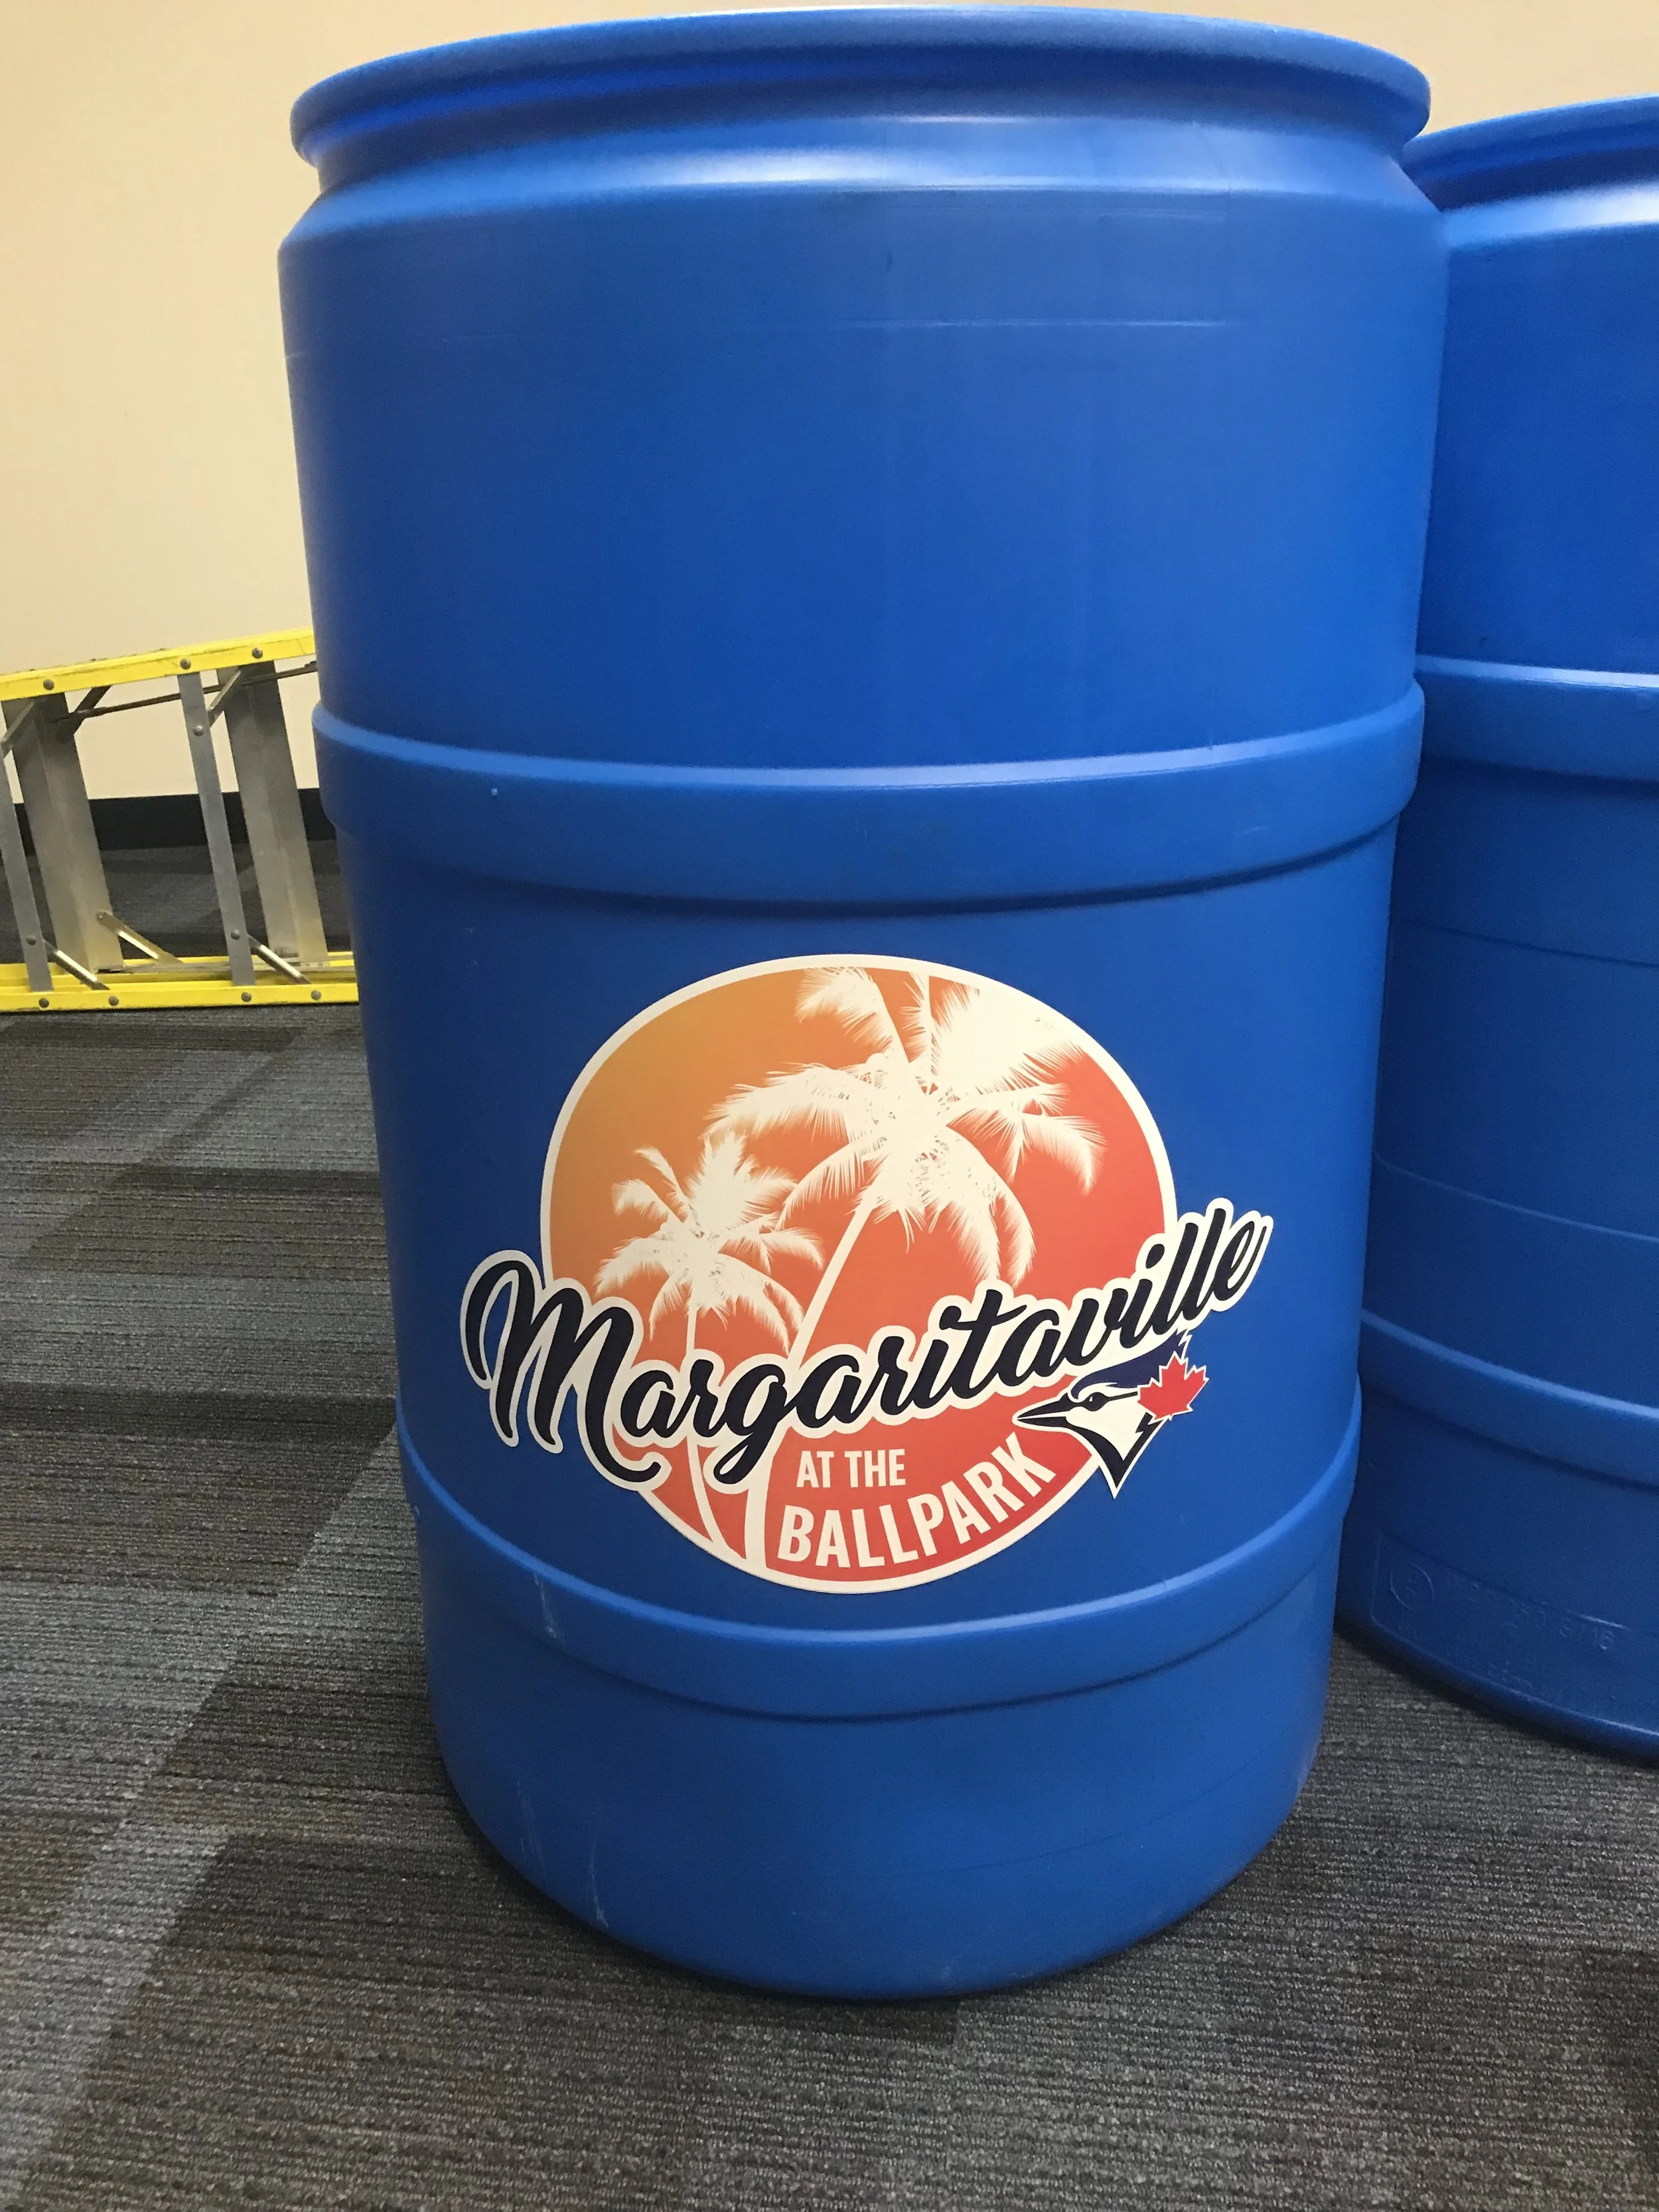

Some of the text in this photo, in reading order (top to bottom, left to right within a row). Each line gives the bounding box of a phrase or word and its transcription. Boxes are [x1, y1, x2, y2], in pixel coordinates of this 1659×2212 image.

[465, 1207, 1267, 1485] Margaritaville
[777, 1432, 1056, 1568] BALLPARK
[796, 1448, 906, 1489] AT THE
